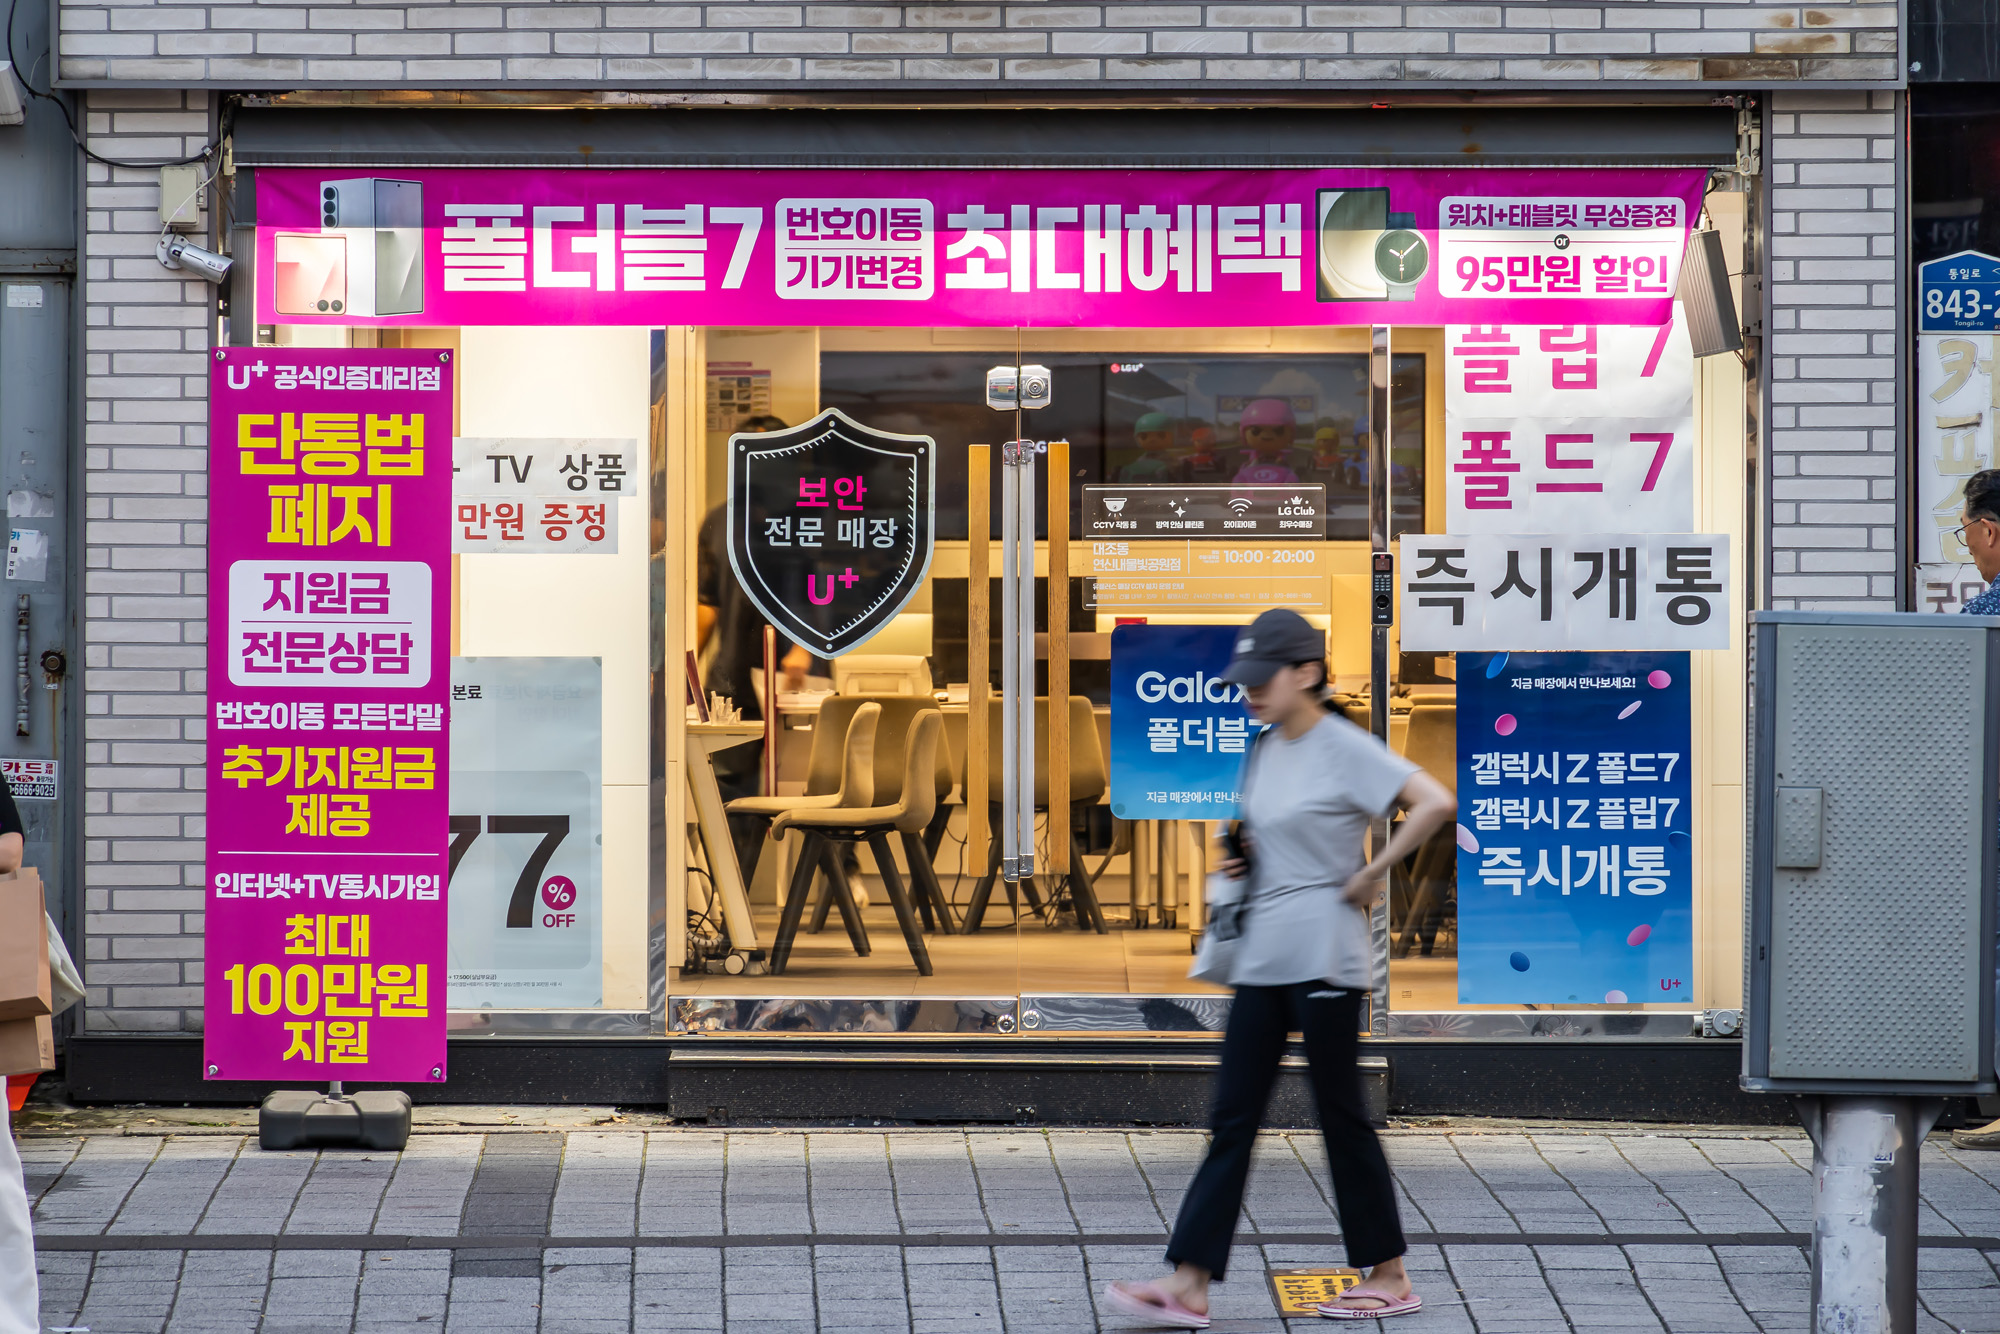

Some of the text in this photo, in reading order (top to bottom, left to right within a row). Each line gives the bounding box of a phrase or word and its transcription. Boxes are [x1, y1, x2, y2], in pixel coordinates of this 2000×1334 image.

[786, 207, 923, 242] 번호이동
[1448, 203, 1677, 228] 워치+태블릿 무상증정
[441, 203, 763, 291] 폴더블7
[945, 203, 1302, 293] 최대혜택
[1555, 236, 1569, 247] or
[786, 254, 923, 290] 기기변경
[1456, 255, 1668, 293] 95만원 할인
[1948, 268, 1982, 280] 통일로
[1954, 320, 1984, 328] Tongil-ro
[227, 360, 441, 391] U+ 공식인증대리점
[237, 412, 424, 476] 단통법
[486, 455, 534, 484] TV
[559, 453, 627, 491] 상품
[796, 476, 867, 511] 보안
[267, 483, 392, 546] 폐지
[458, 503, 606, 541] 만원 증정
[1093, 521, 1137, 529] CCTV 작동 중
[1156, 521, 1169, 529] 방역
[1223, 521, 1257, 529] 와이파이존
[1278, 506, 1315, 516] LG Club
[1279, 520, 1313, 529] 최우수매장
[764, 516, 899, 548] 전문 매장
[1093, 542, 1129, 555] 대조동
[1223, 549, 1264, 563] 10:00
[1272, 549, 1315, 563] 20:00
[262, 571, 390, 614] 지원금
[807, 567, 860, 606] U+
[1407, 546, 1722, 626] 즉시개통
[242, 631, 413, 674] 전문상담
[452, 684, 482, 700] 본료
[1136, 671, 1252, 704] Galax
[1511, 677, 1636, 690] 지금 매장에서 만나보세요!
[216, 701, 443, 731] 번호이동 모든단말
[221, 744, 436, 790] 추가지원금
[1471, 751, 1680, 785] 갤럭시 Z 폴드7
[1146, 791, 1246, 803] 지금 매장에서 만나보
[1471, 796, 1680, 830] 갤럭시 Z 플립7
[285, 794, 371, 837] 제공
[215, 872, 440, 901] 인터넷+TV동시가입
[1478, 845, 1671, 896] 즉시개통
[284, 914, 370, 957] 최대
[543, 914, 576, 928] OFF
[223, 963, 429, 1018] 100만원
[1660, 978, 1682, 991] U+
[282, 1020, 369, 1064] 지원
[1352, 1310, 1379, 1318] crocs
